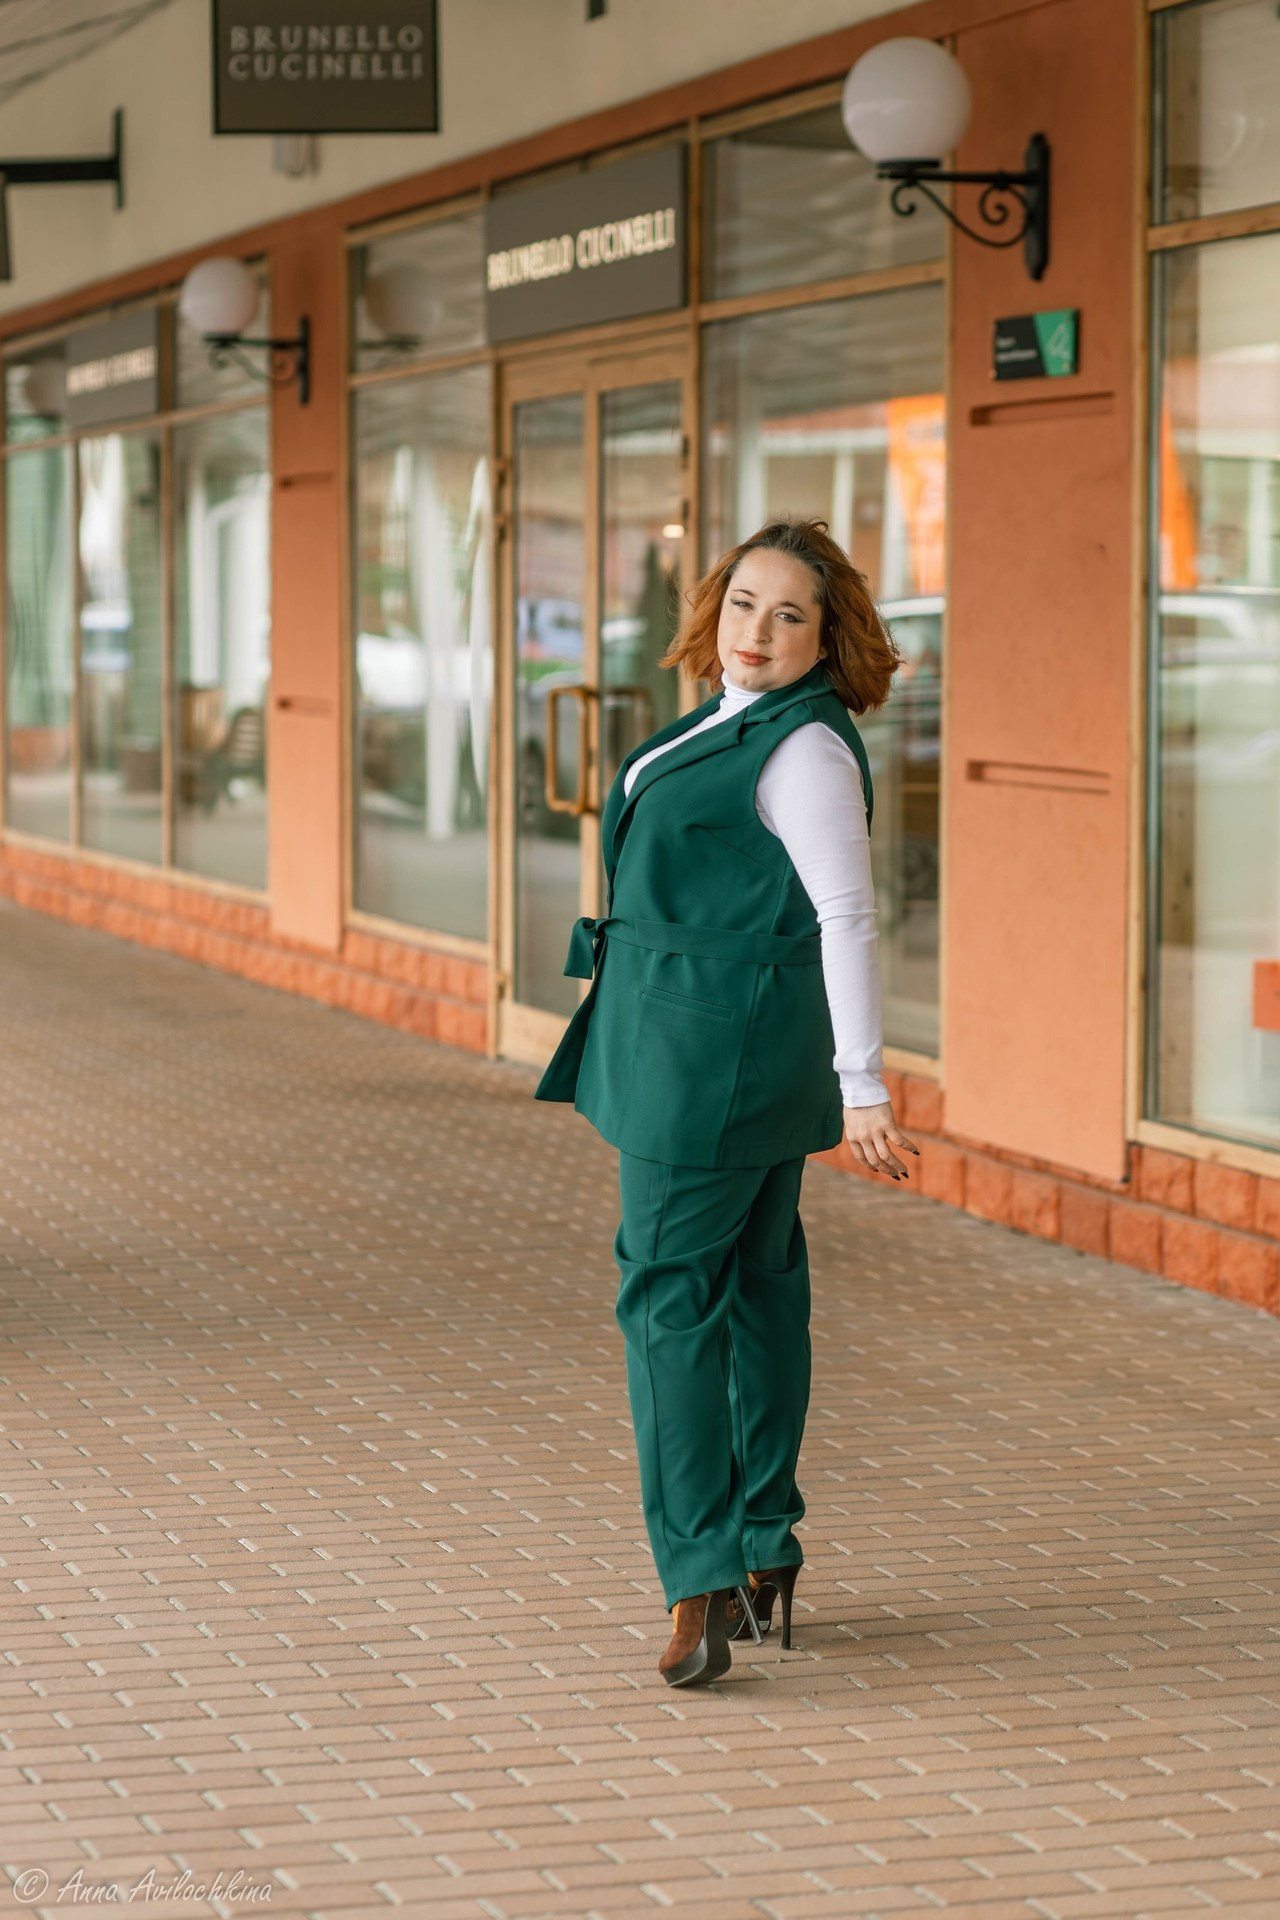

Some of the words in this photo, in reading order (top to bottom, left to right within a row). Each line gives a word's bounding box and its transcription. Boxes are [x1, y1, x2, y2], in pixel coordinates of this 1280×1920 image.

[230, 24, 423, 51] BRUNELLO
[228, 53, 423, 81] CUCINELLI
[487, 234, 574, 291] BRUNELLO
[576, 208, 675, 269] CUCINELLI
